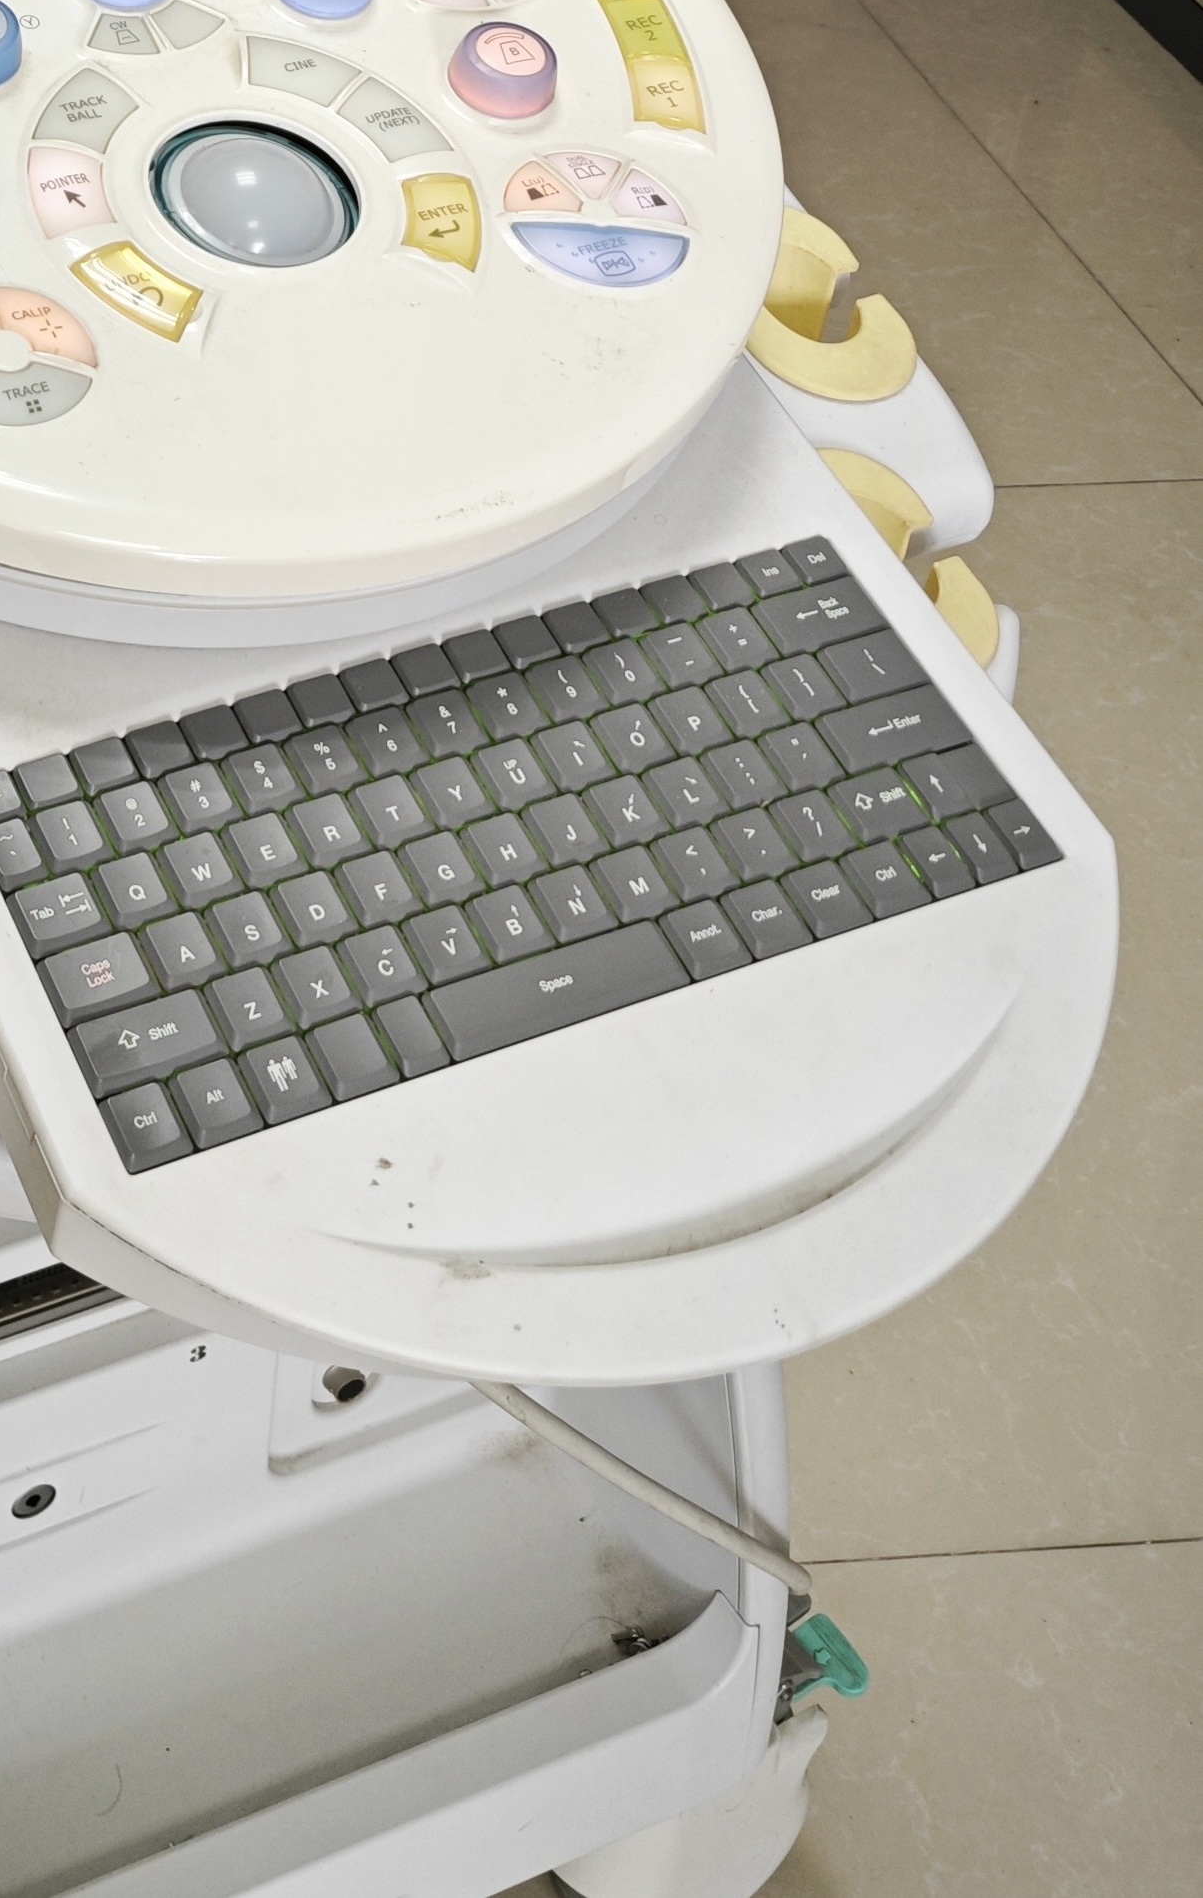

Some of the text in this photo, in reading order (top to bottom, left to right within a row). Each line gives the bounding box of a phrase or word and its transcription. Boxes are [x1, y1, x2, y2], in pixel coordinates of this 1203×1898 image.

[109, 20, 129, 31] CW
[626, 14, 662, 33] REC
[645, 30, 657, 42] 2
[284, 58, 318, 73] CINE
[647, 80, 685, 100] REC
[58, 93, 106, 112] TRACK
[668, 96, 677, 108] 1
[66, 106, 103, 123] BALL
[365, 106, 411, 126] UPDATE
[377, 113, 420, 132] (NEXT)
[40, 171, 90, 193] POINTER
[521, 176, 544, 186] L(U)
[631, 186, 655, 194] R(D)
[418, 201, 469, 221] ENTER
[578, 235, 627, 255] FREEZE
[11, 305, 51, 321] CALIP
[2, 380, 49, 401] TRACE
[807, 551, 827, 565] Del
[818, 597, 839, 610] Back
[825, 604, 849, 618] Space
[566, 686, 576, 699] 9
[507, 703, 517, 715] 8
[447, 722, 458, 734] 7
[688, 715, 701, 731] P
[893, 712, 921, 729] Enter
[387, 740, 398, 752] 6
[629, 731, 645, 746] O
[325, 757, 336, 771] 5
[263, 776, 274, 789] 4
[510, 768, 526, 785] U
[448, 786, 463, 802] Y
[880, 786, 906, 804] Shift
[199, 796, 210, 809] 3
[134, 814, 145, 826] 2
[387, 806, 400, 821] T
[623, 805, 641, 822] K
[324, 825, 340, 841] R
[260, 844, 276, 860] E
[501, 844, 517, 860] H
[192, 864, 212, 881] W
[439, 864, 454, 880] G
[876, 866, 897, 881] Ctrl
[129, 885, 145, 902] Q
[375, 884, 388, 900] F
[631, 878, 650, 895] M
[811, 882, 841, 900] Clear
[30, 903, 55, 921] Tab
[310, 904, 325, 921] D
[567, 898, 586, 914] N
[752, 905, 782, 920] Char.
[244, 925, 260, 941] S
[507, 919, 522, 935] B
[690, 925, 722, 943] Annot.
[179, 946, 196, 962] A
[442, 939, 458, 955] V
[81, 959, 111, 979] Caps
[378, 959, 393, 976] C
[86, 969, 115, 986] Lock
[538, 972, 573, 993] Space
[311, 980, 329, 997] X
[244, 1003, 261, 1019] Z
[149, 1021, 179, 1040] Shift
[206, 1089, 224, 1104] Alt
[134, 1111, 157, 1128] Ctrl
